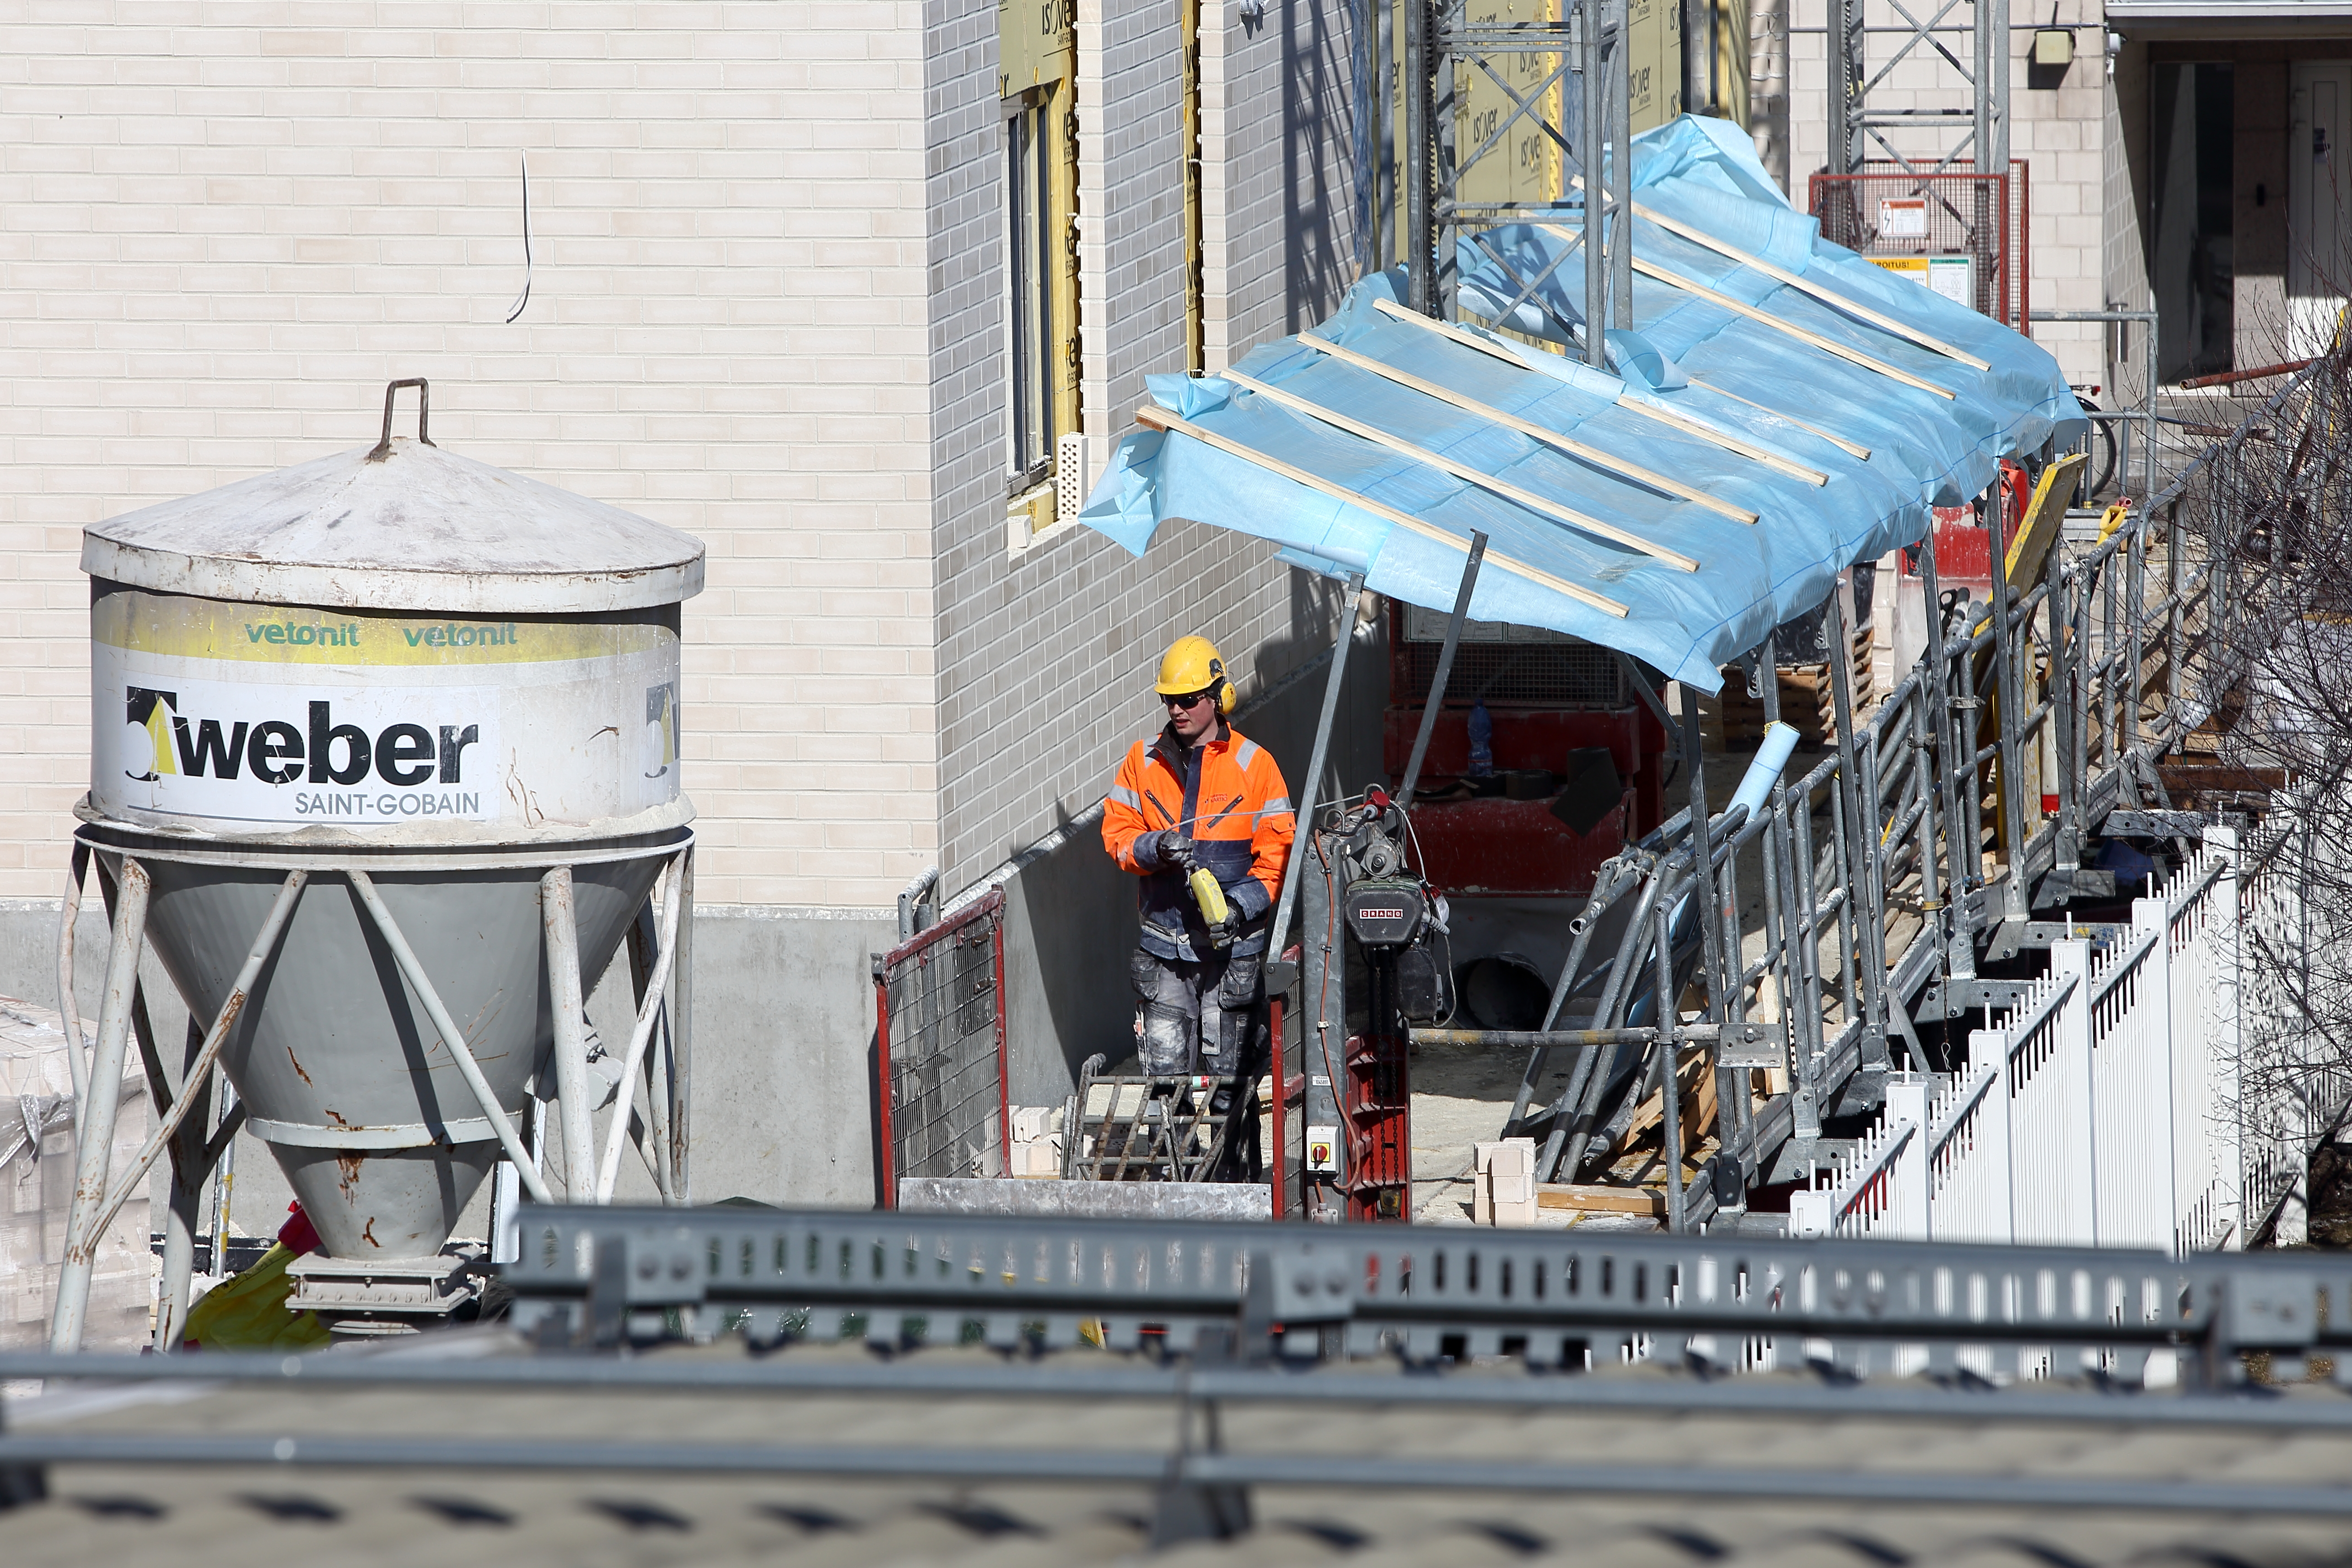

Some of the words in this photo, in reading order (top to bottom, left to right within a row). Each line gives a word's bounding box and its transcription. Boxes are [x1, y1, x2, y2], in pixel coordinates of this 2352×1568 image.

[244, 621, 361, 647] vetonit
[403, 622, 518, 647] vetonit
[172, 700, 479, 786] weber
[295, 792, 479, 815] SAINT-GOBAIN
